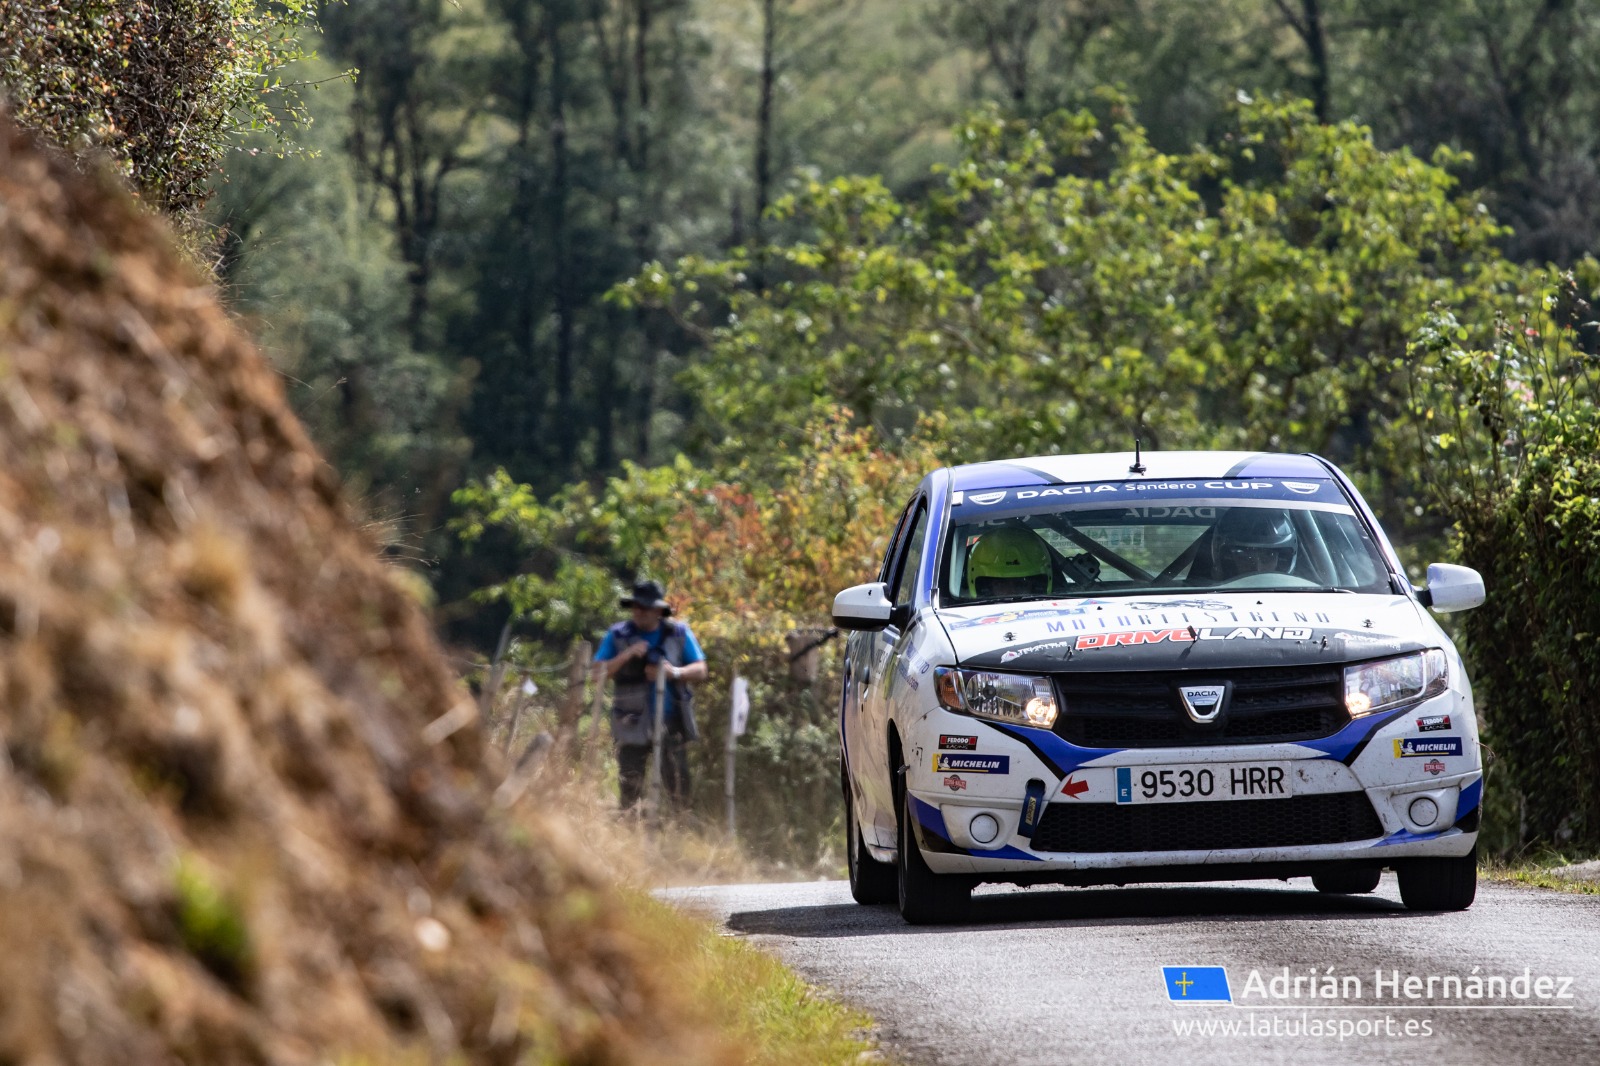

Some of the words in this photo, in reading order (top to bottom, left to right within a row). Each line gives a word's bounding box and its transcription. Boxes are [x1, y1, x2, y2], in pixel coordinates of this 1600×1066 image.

[1016, 484, 1117, 499] DACIA
[1125, 482, 1197, 491] Sandero
[1204, 481, 1274, 490] CUP
[1416, 743, 1457, 752] MICHELIN
[951, 759, 1000, 769] MICHELIN
[1121, 789, 1128, 797] E
[1140, 769, 1215, 798] 9530
[1230, 767, 1286, 796] HRR
